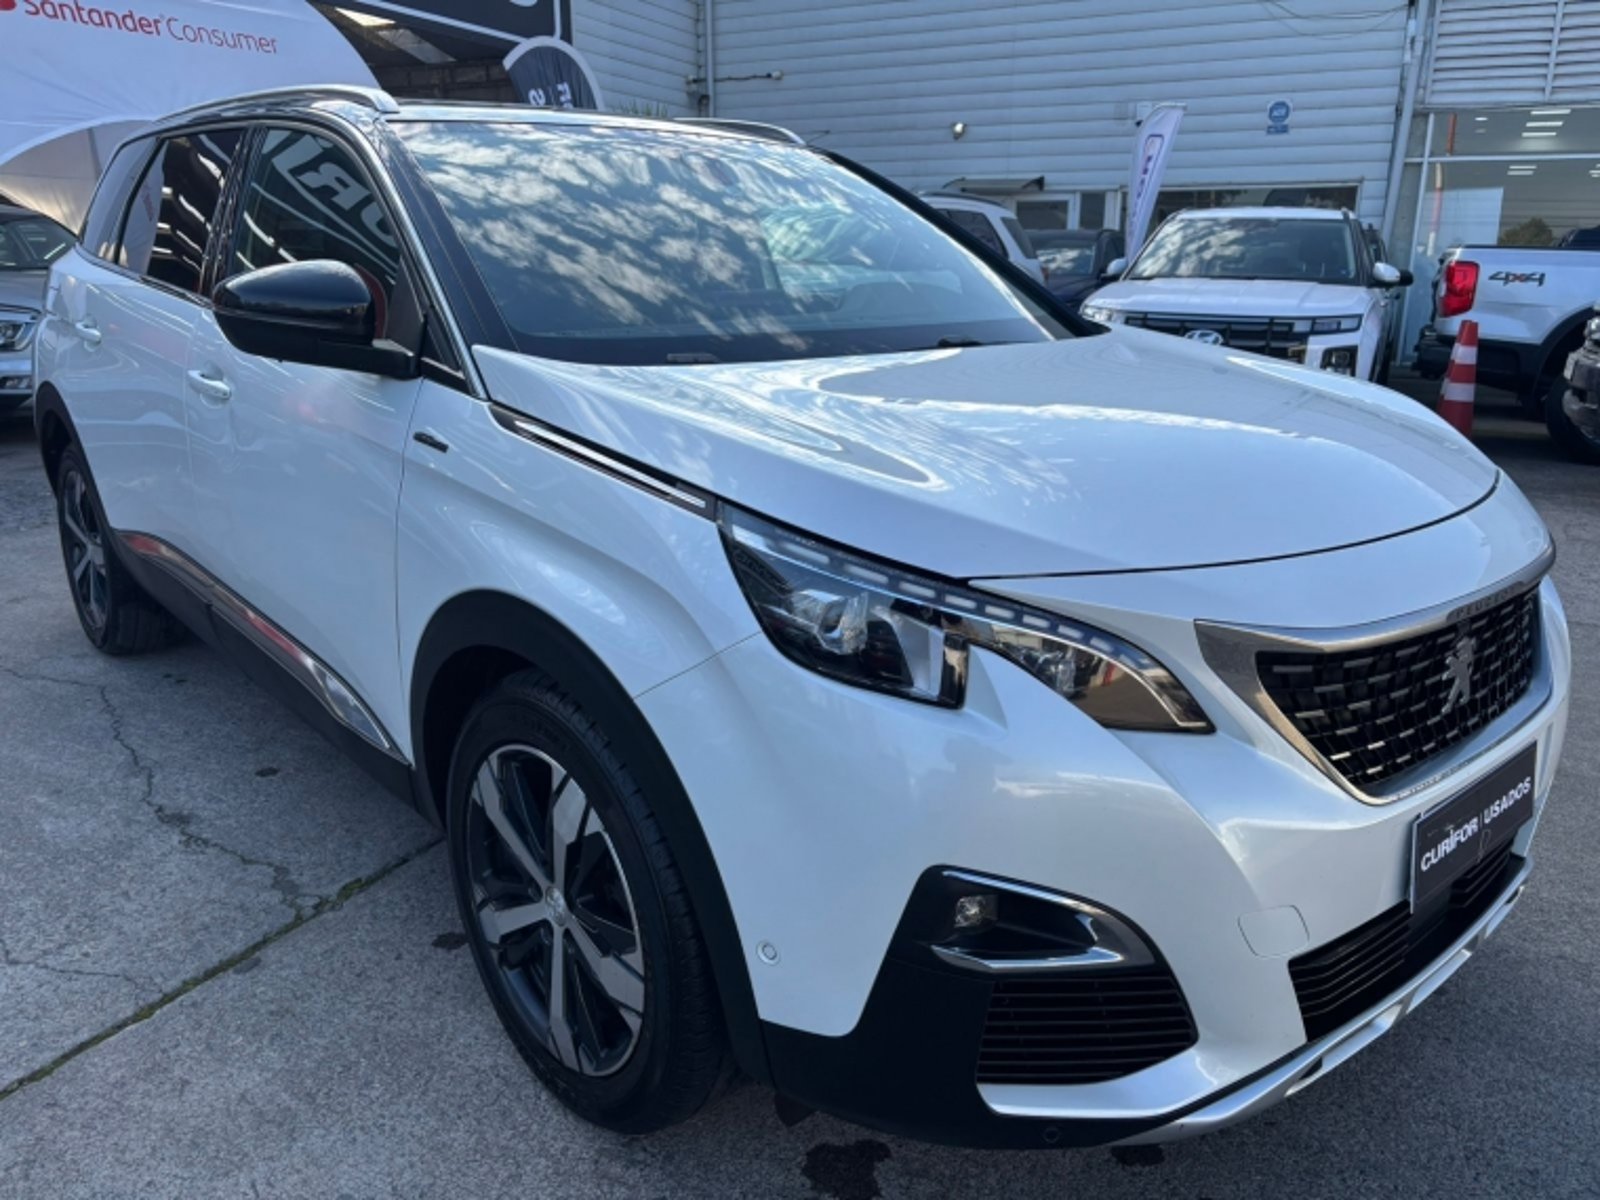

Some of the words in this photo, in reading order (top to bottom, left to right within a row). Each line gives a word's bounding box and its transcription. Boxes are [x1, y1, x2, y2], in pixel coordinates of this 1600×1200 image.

[24, 0, 161, 36] Santander
[166, 17, 278, 54] Consumer
[1483, 776, 1532, 825] USADOS
